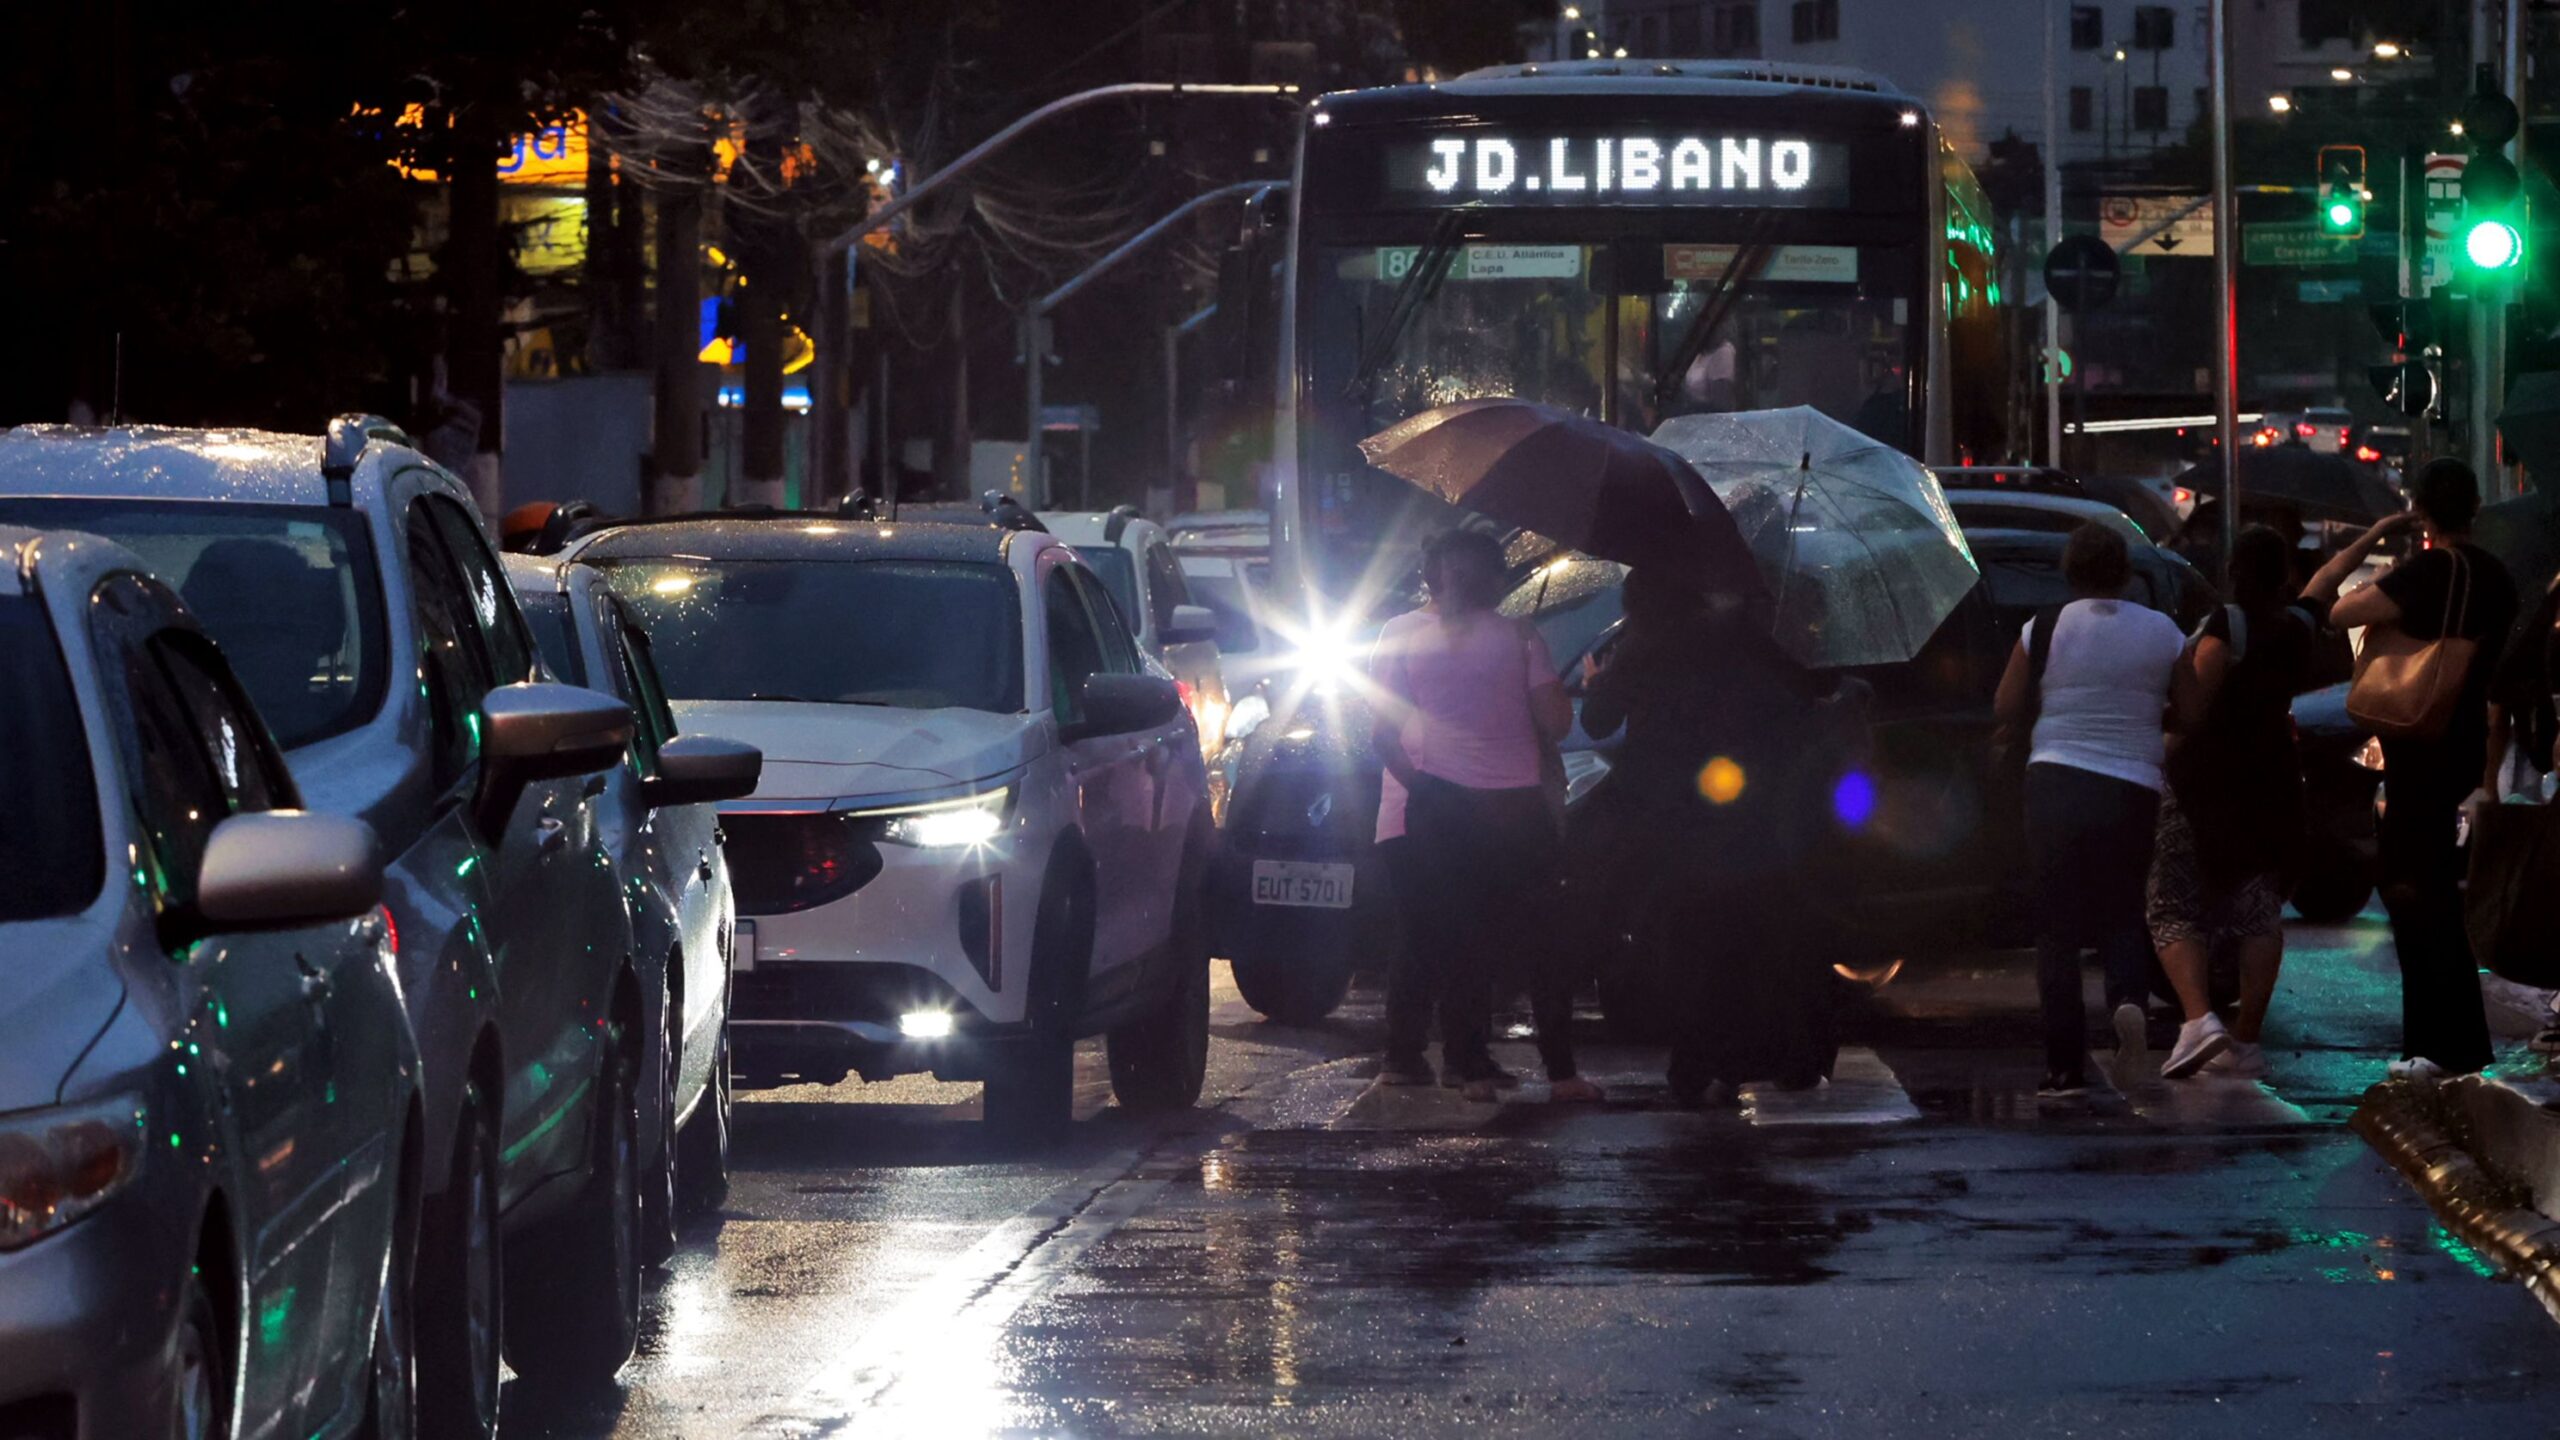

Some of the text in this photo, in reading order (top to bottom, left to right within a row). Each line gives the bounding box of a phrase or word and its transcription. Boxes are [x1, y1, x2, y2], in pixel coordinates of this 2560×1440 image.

[1426, 137, 1811, 190] JD.LIBANO
[1471, 264, 1504, 275] Lapa
[1299, 878, 1345, 902] 5701
